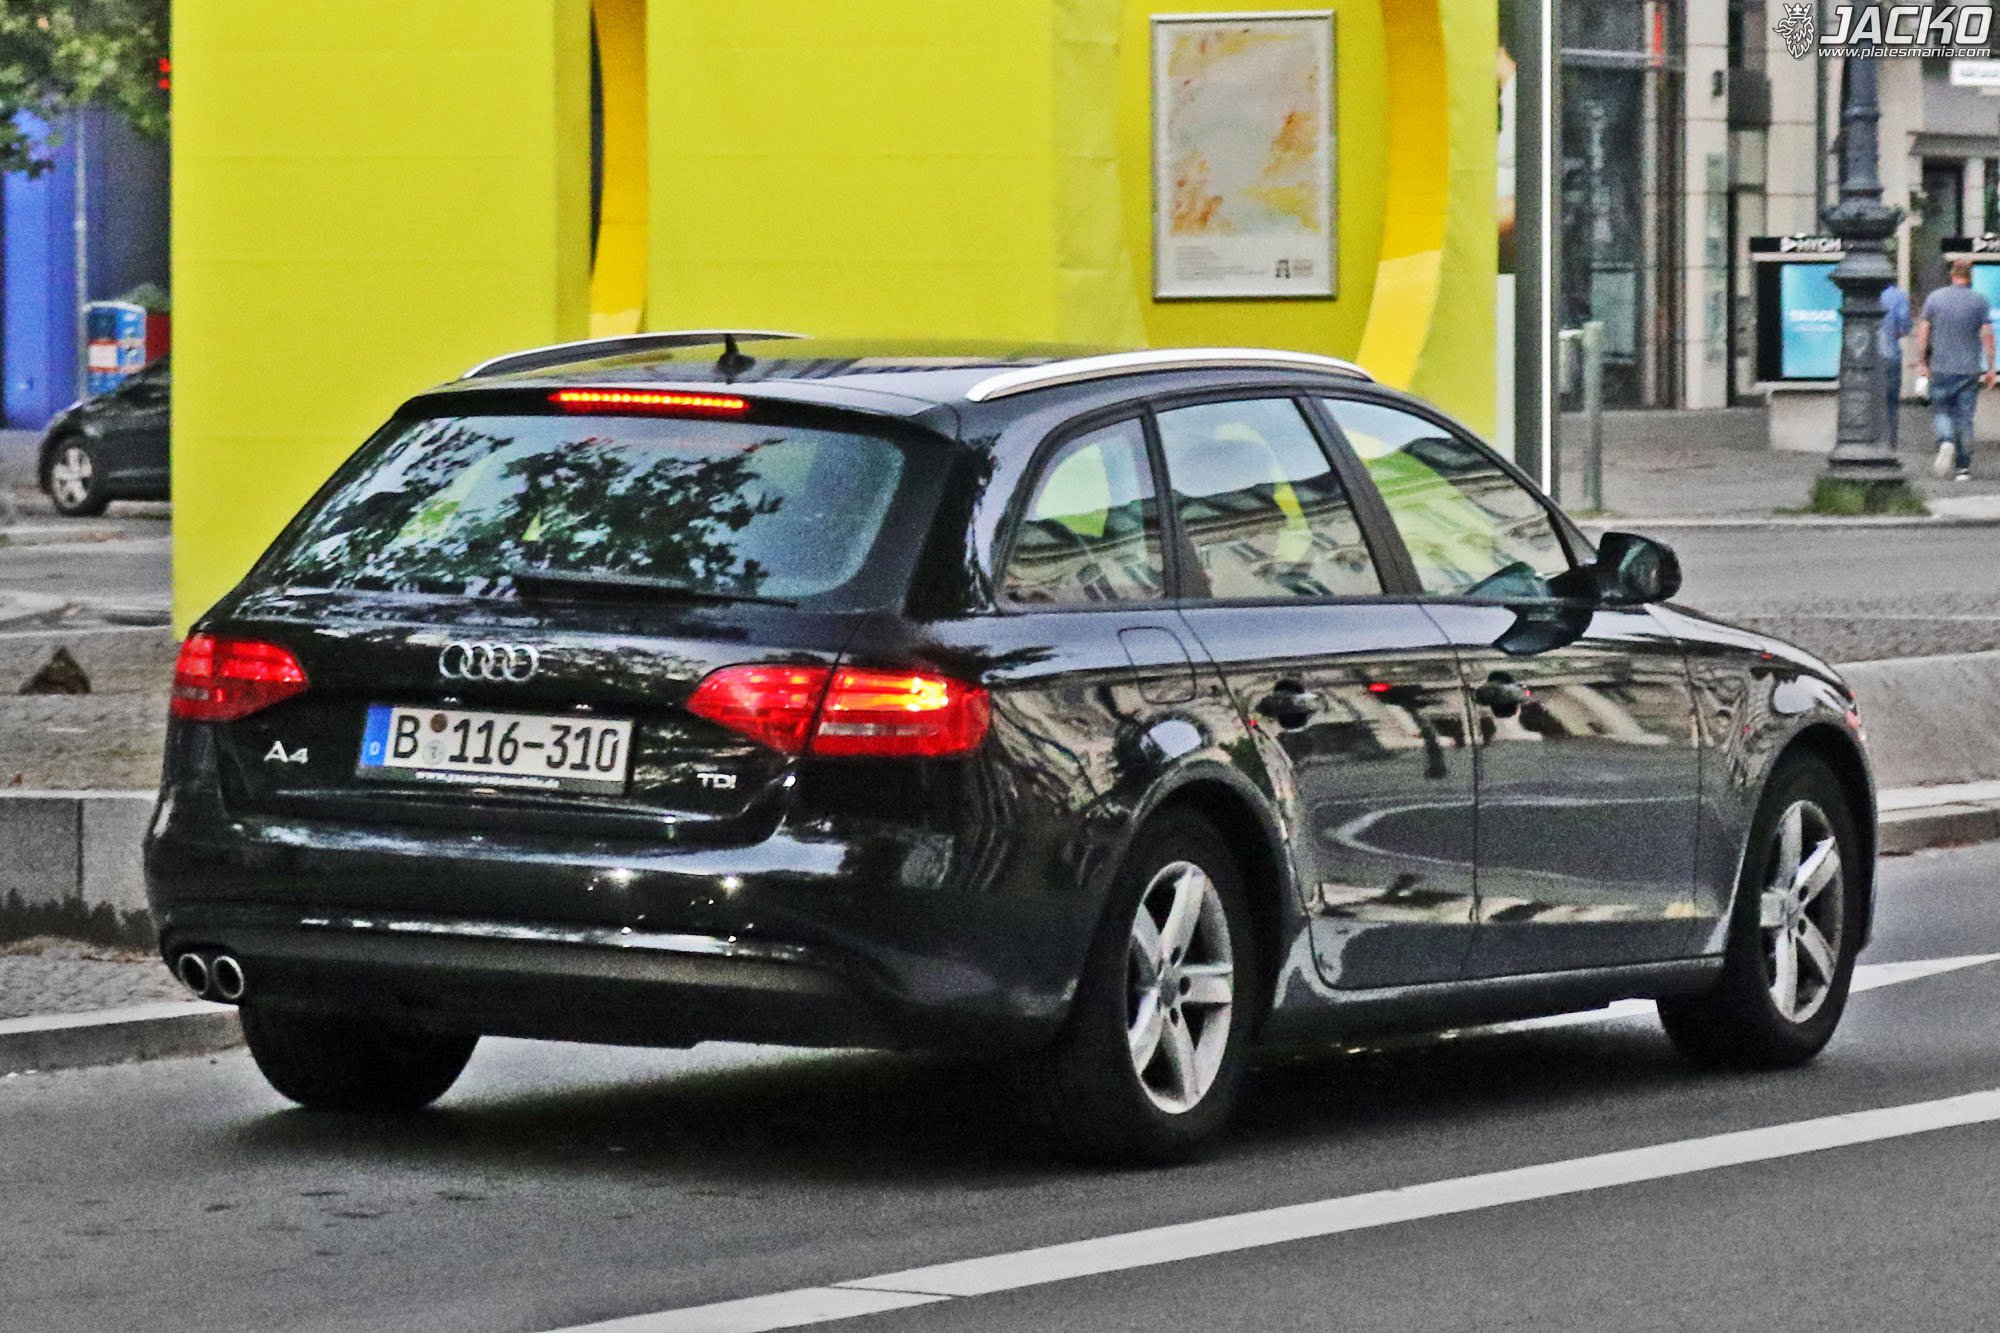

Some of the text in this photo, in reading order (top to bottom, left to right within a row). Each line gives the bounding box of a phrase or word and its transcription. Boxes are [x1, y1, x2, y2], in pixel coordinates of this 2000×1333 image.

[263, 740, 309, 764] A4
[369, 741, 381, 755] D
[393, 715, 620, 772] B 116-310
[696, 772, 737, 789] TDI
